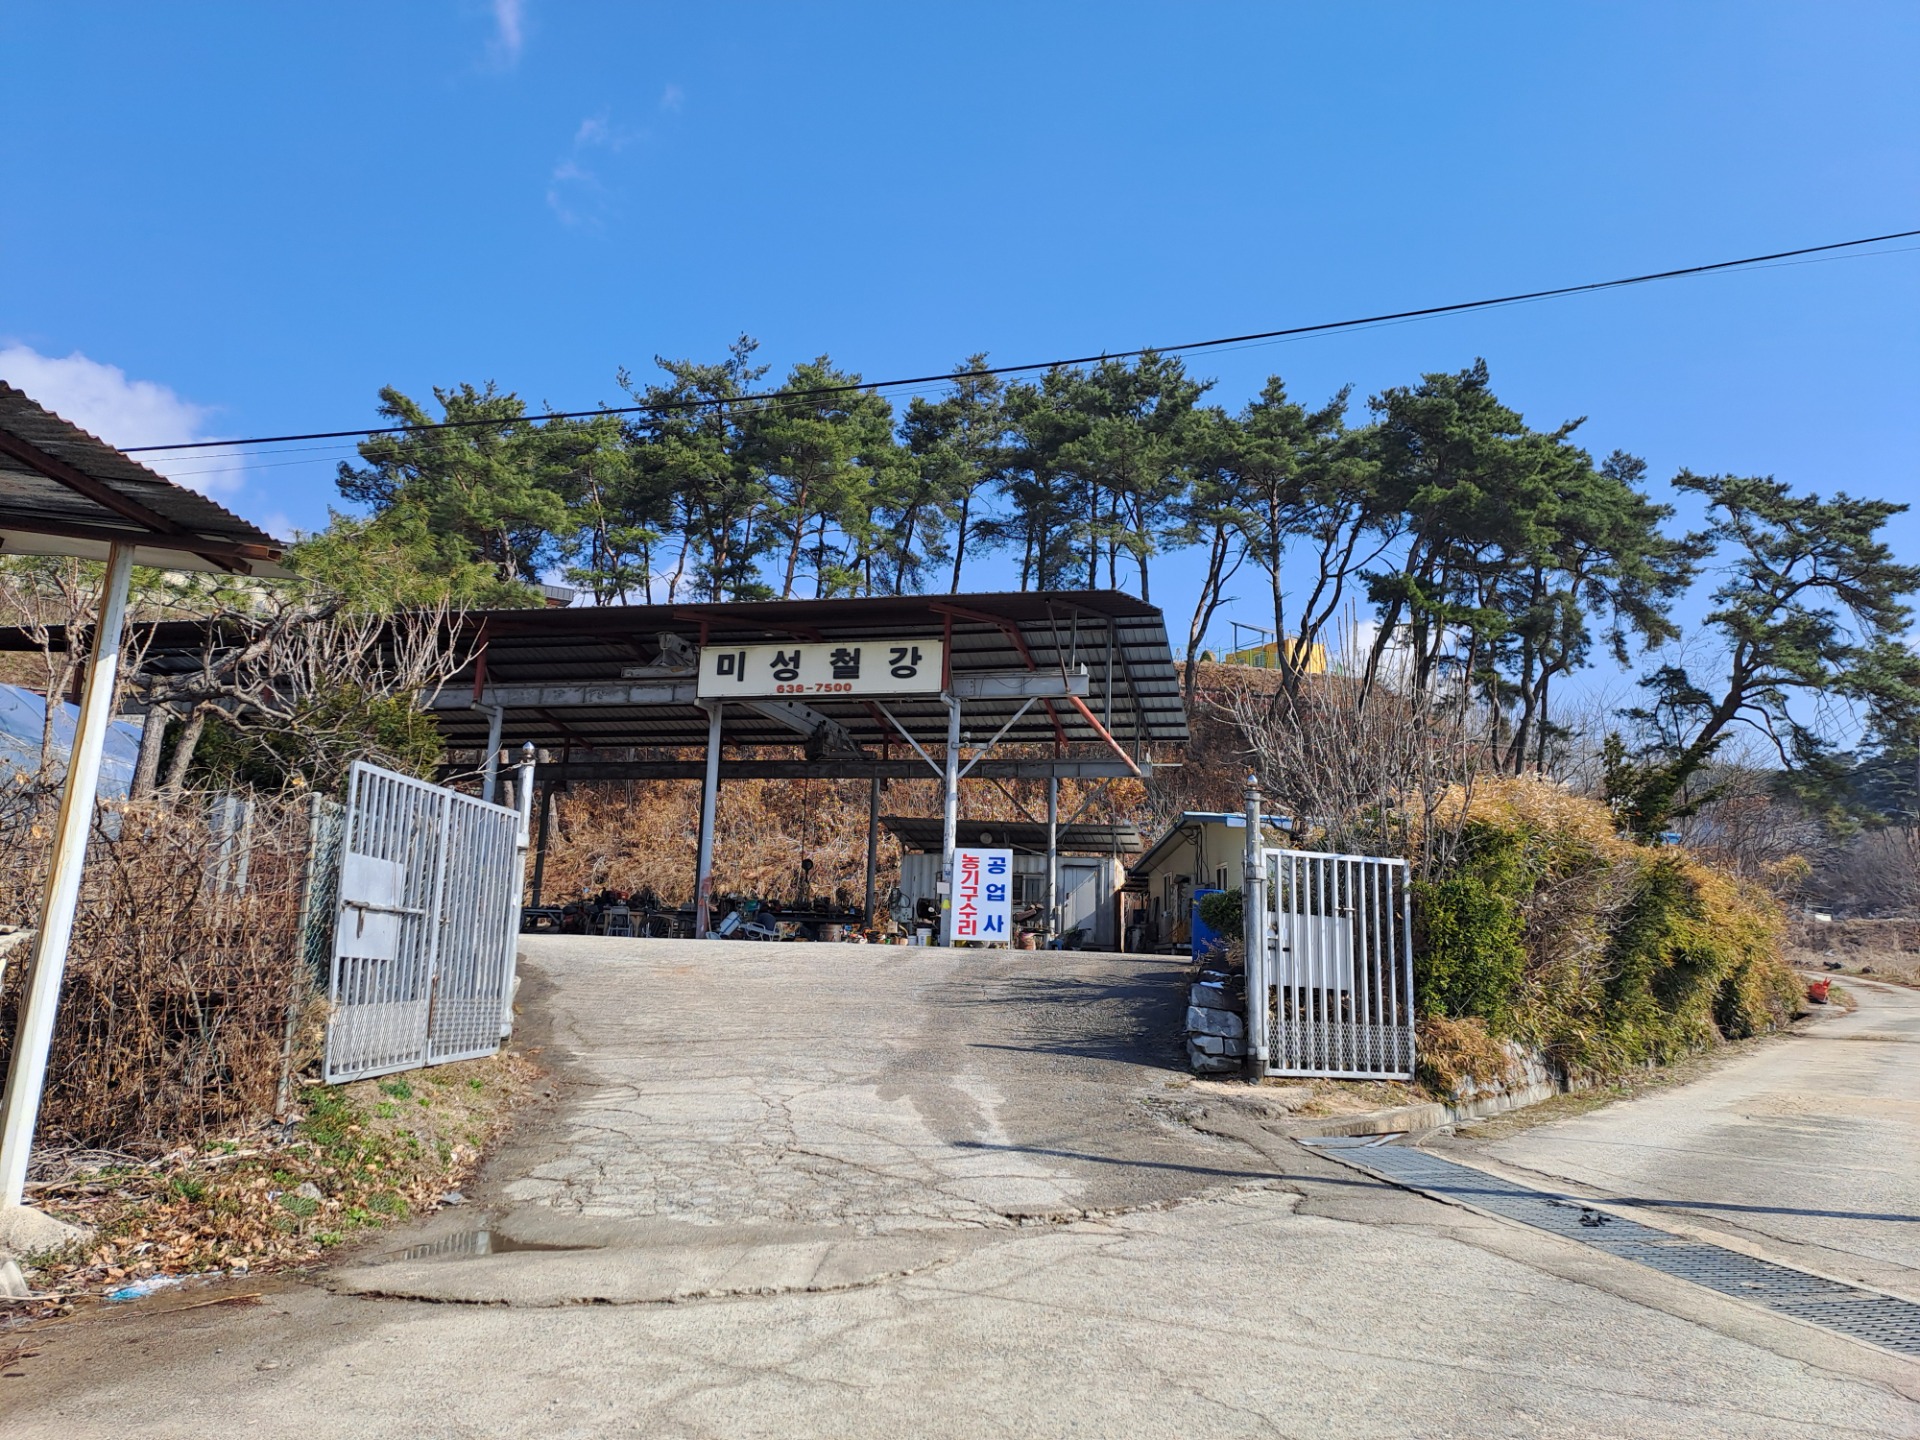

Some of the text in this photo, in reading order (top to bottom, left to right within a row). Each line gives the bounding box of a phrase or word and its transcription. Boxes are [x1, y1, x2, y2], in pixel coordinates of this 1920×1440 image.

[717, 646, 922, 682] 미성철강
[776, 683, 852, 693] 638-7500
[958, 853, 980, 936] 농기구수리
[983, 856, 1006, 933] 공업사
